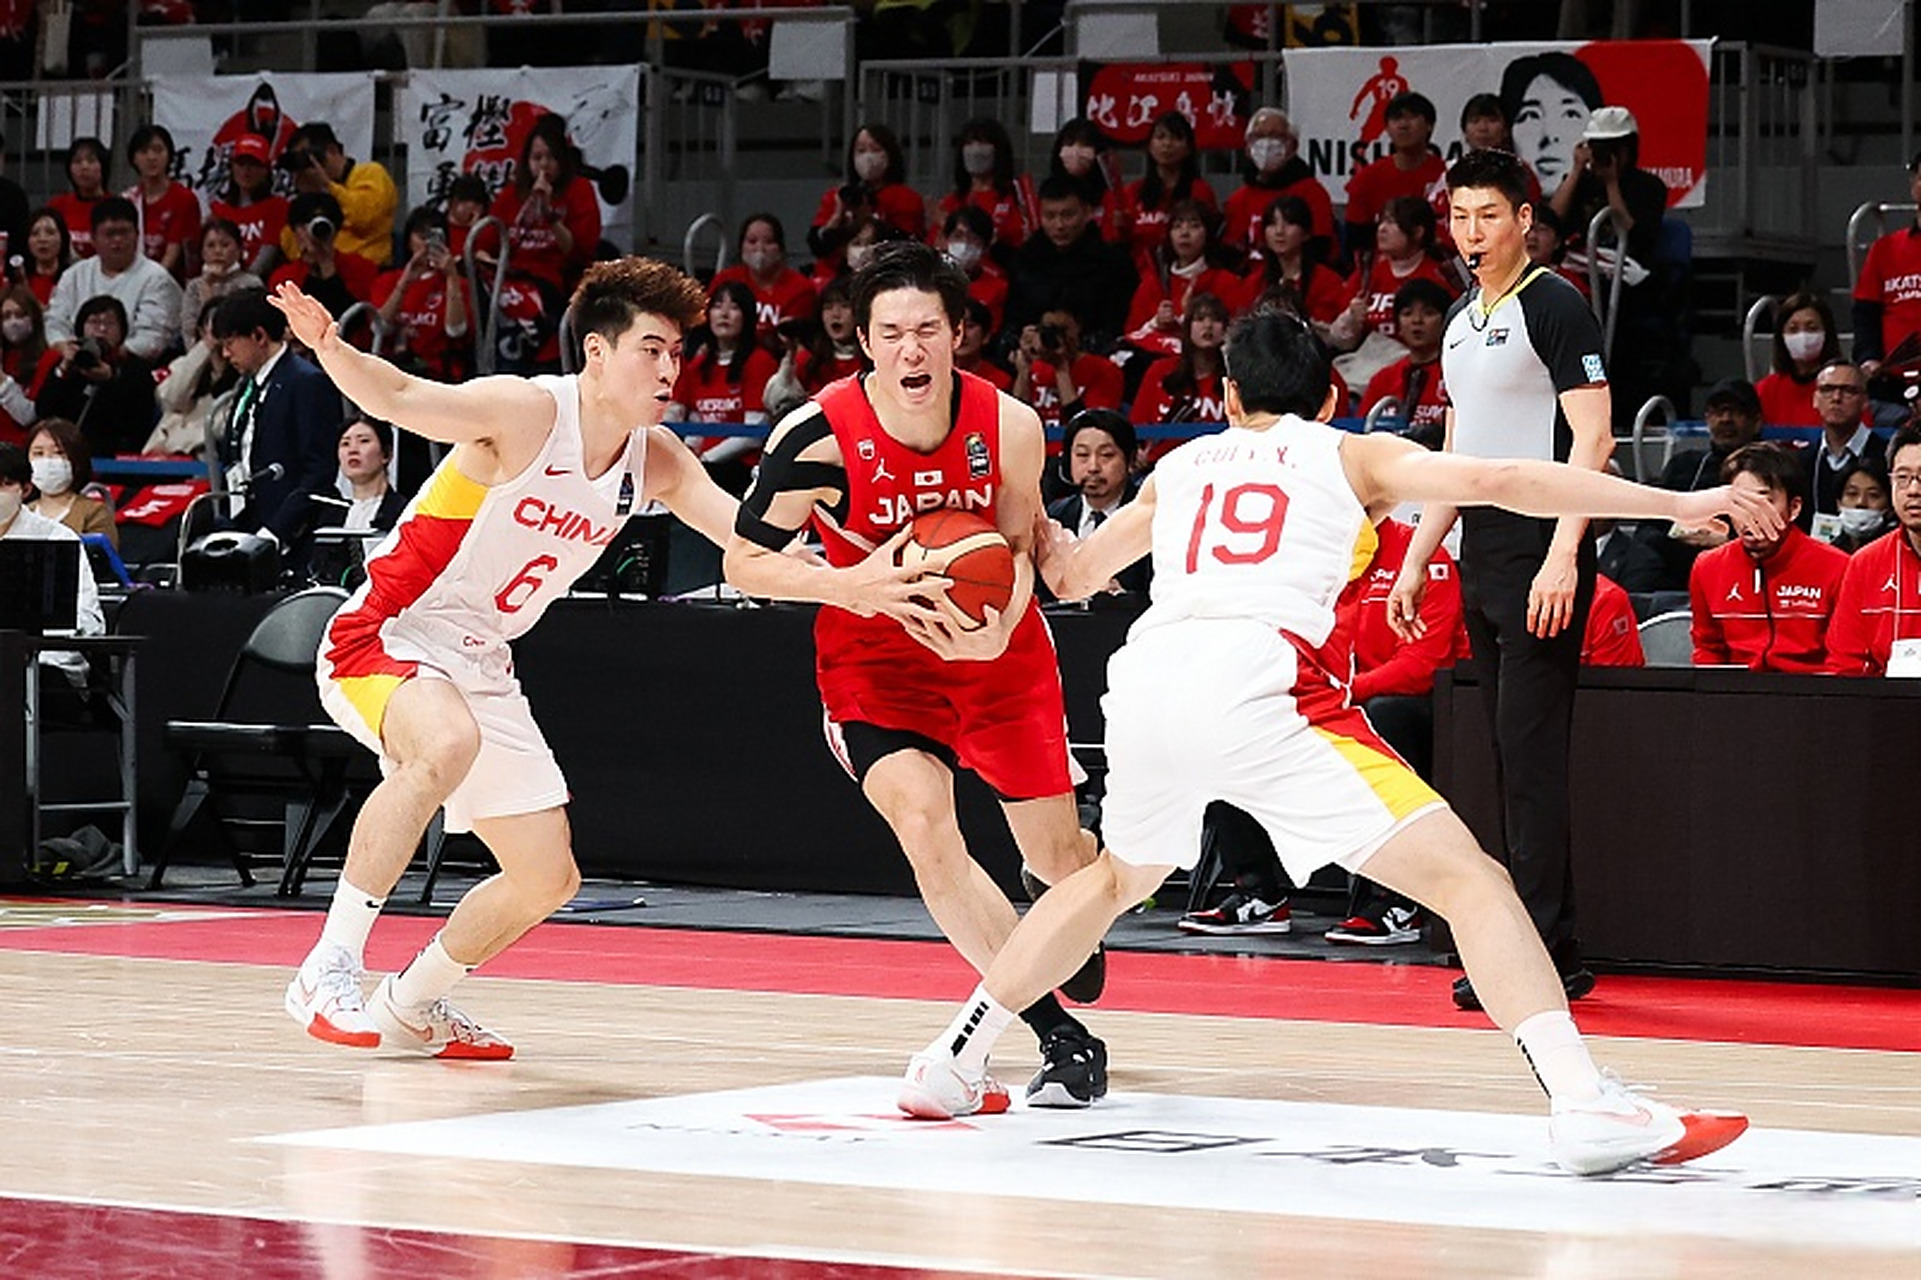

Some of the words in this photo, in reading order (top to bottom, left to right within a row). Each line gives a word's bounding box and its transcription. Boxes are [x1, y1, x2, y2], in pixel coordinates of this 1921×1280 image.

[1378, 79, 1399, 99] 19
[868, 483, 992, 525] JAPAN
[1186, 482, 1290, 575] 19
[494, 554, 558, 614] 6
[1776, 584, 1822, 599] JAPAN
